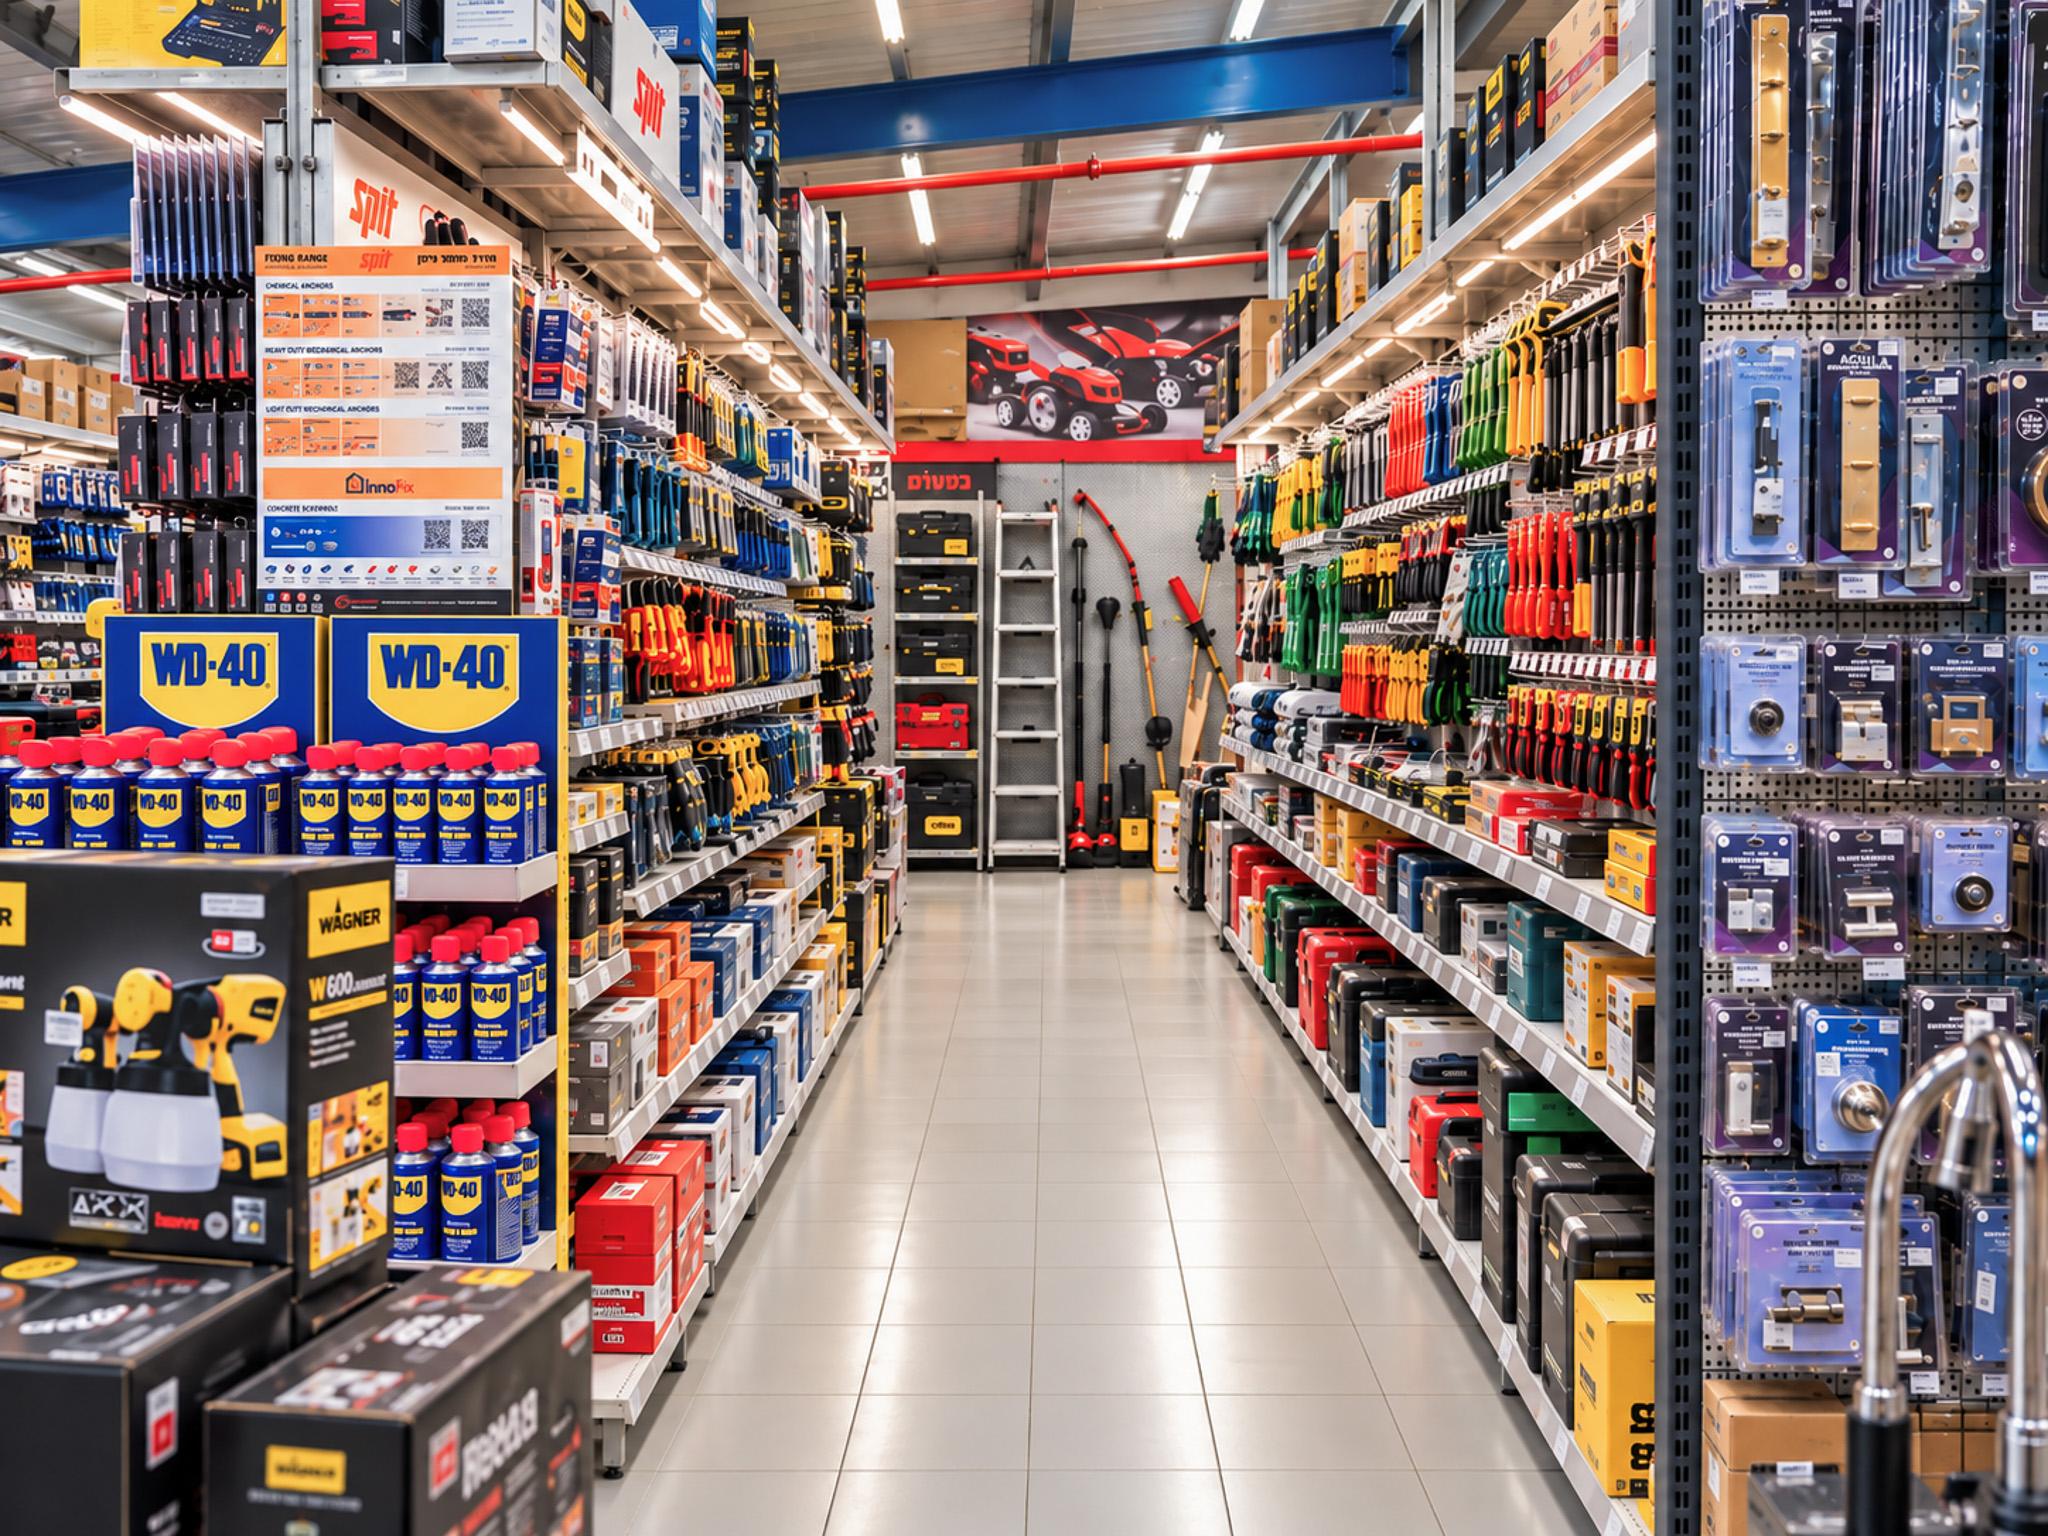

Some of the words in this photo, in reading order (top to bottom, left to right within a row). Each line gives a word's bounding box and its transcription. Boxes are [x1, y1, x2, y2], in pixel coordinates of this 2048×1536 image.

[633, 66, 667, 140] spit
[349, 178, 399, 240] spit
[359, 248, 393, 272] spit
[151, 642, 267, 687] WD-40
[380, 644, 506, 690] WD-40
[318, 900, 381, 935] WAGNER
